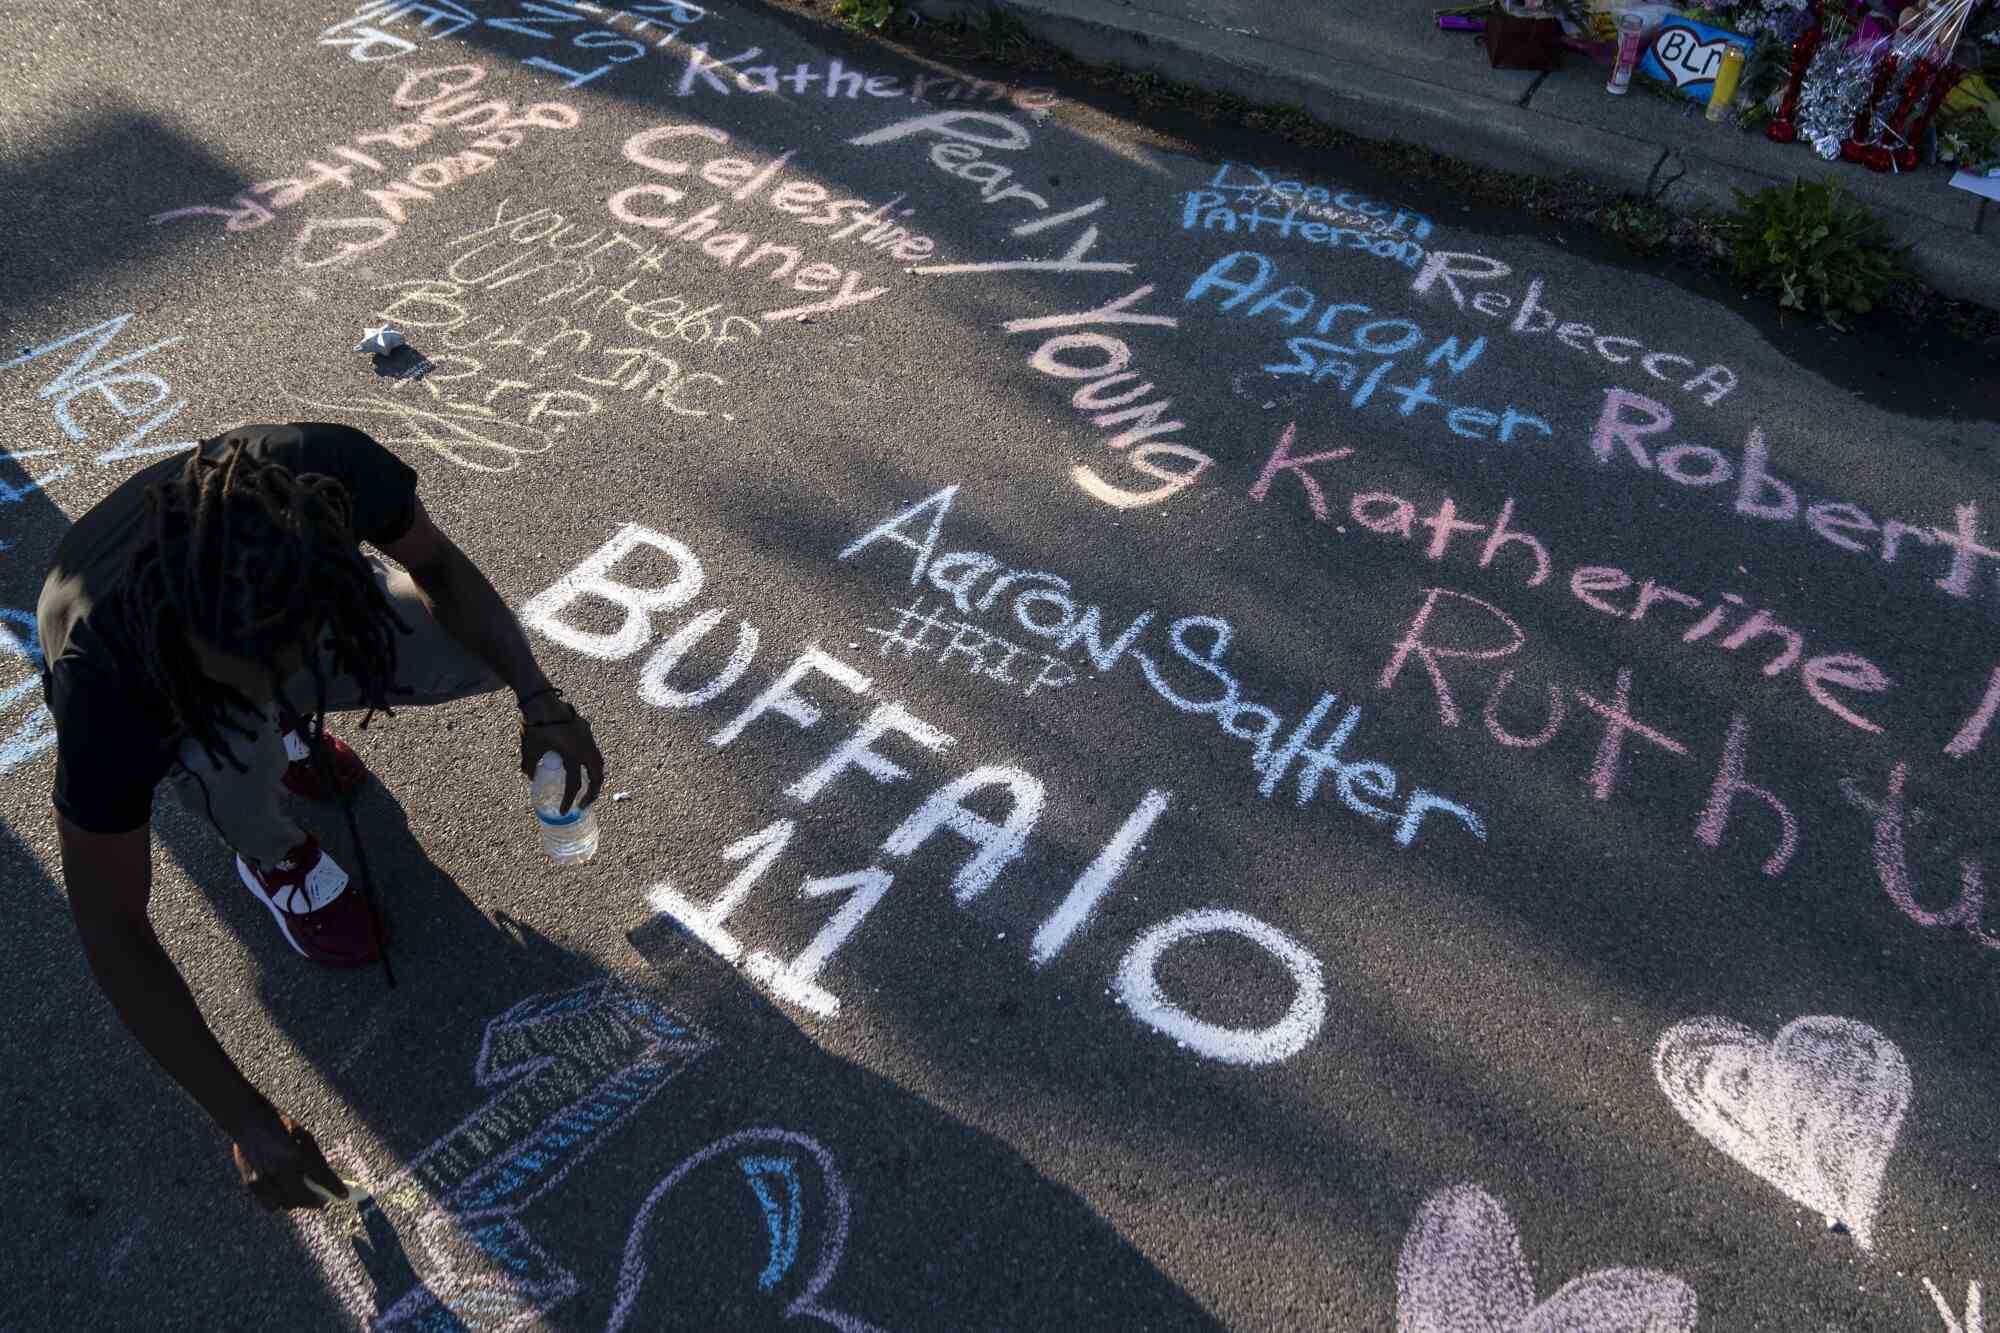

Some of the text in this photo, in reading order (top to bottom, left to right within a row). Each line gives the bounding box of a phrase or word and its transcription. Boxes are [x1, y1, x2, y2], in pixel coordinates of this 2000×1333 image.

[676, 45, 1062, 105] Katherine
[607, 183, 891, 323] Chaney
[621, 124, 937, 261] Celestine
[1177, 190, 1425, 268] Patterson
[1206, 160, 1435, 241] Deacon
[1248, 421, 1892, 733] Katherine
[865, 595, 1078, 698] #RIP
[1132, 615, 1487, 848] Salter
[1375, 587, 1797, 877] Ruth
